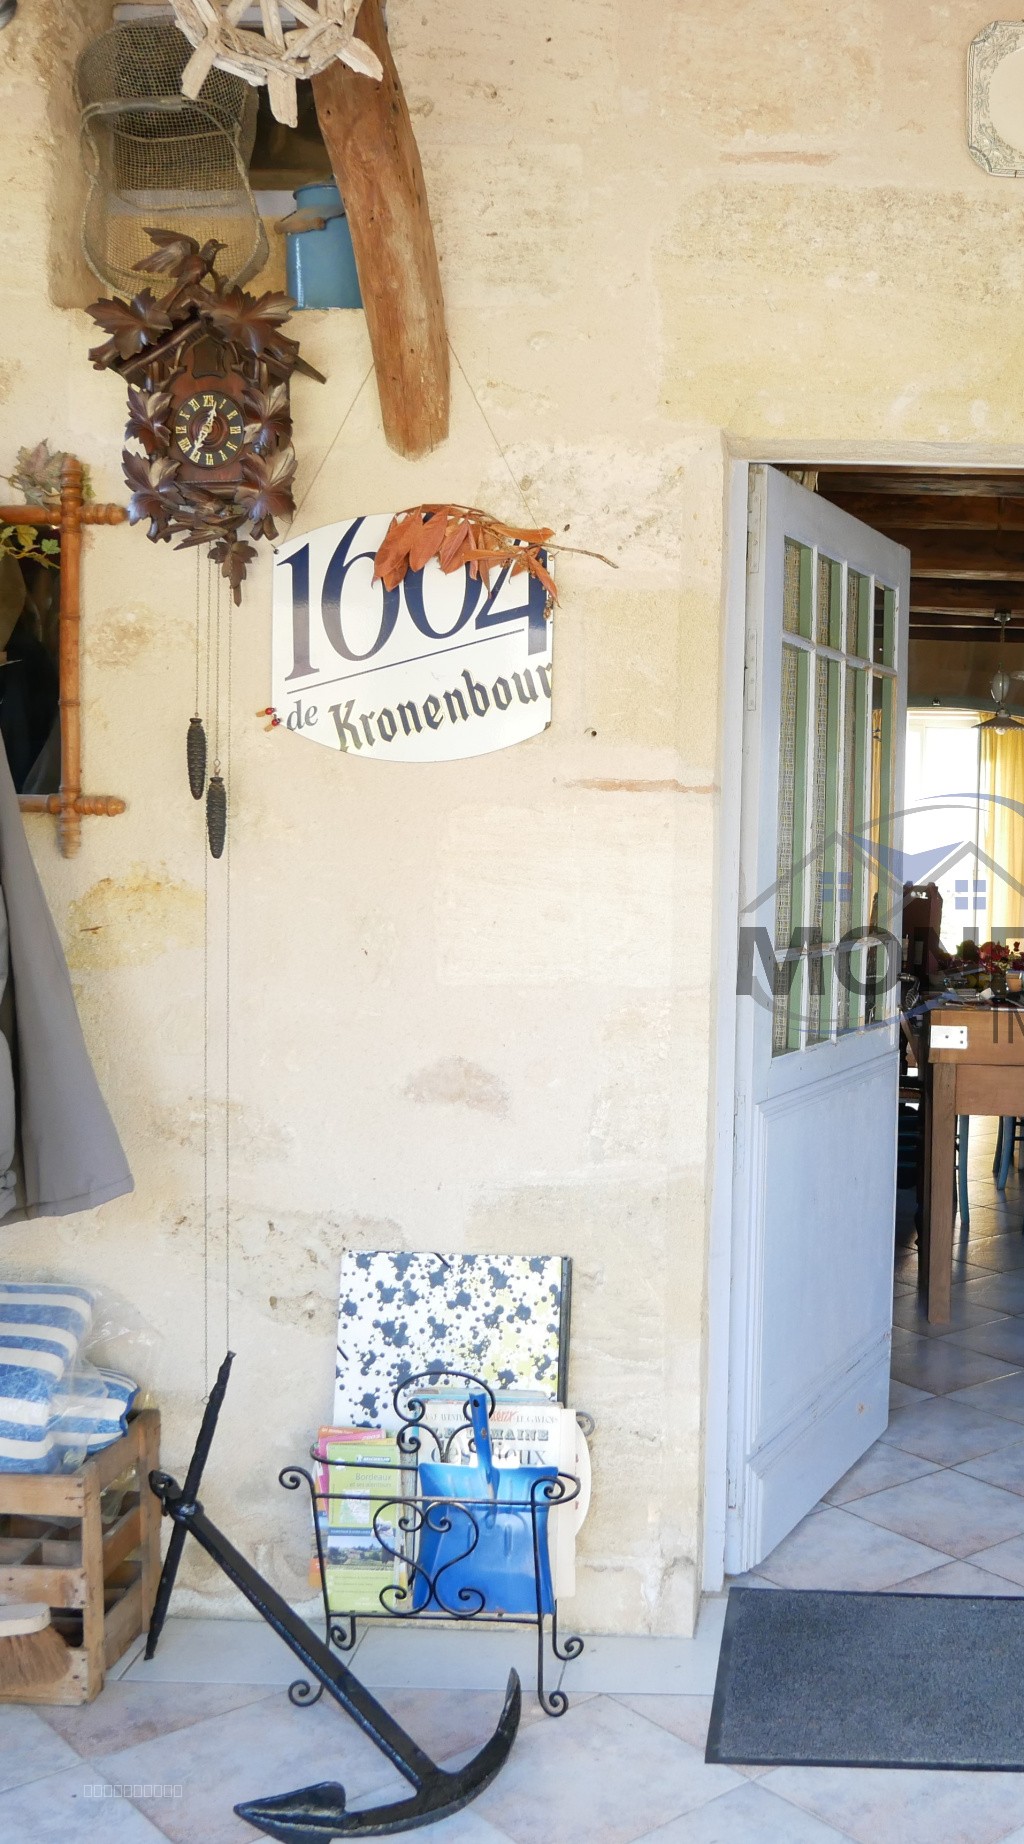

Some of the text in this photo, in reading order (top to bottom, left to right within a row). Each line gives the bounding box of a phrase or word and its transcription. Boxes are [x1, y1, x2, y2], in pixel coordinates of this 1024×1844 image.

[286, 662, 552, 752] de Kronenbour
[355, 1473, 391, 1481] Bordeaux
